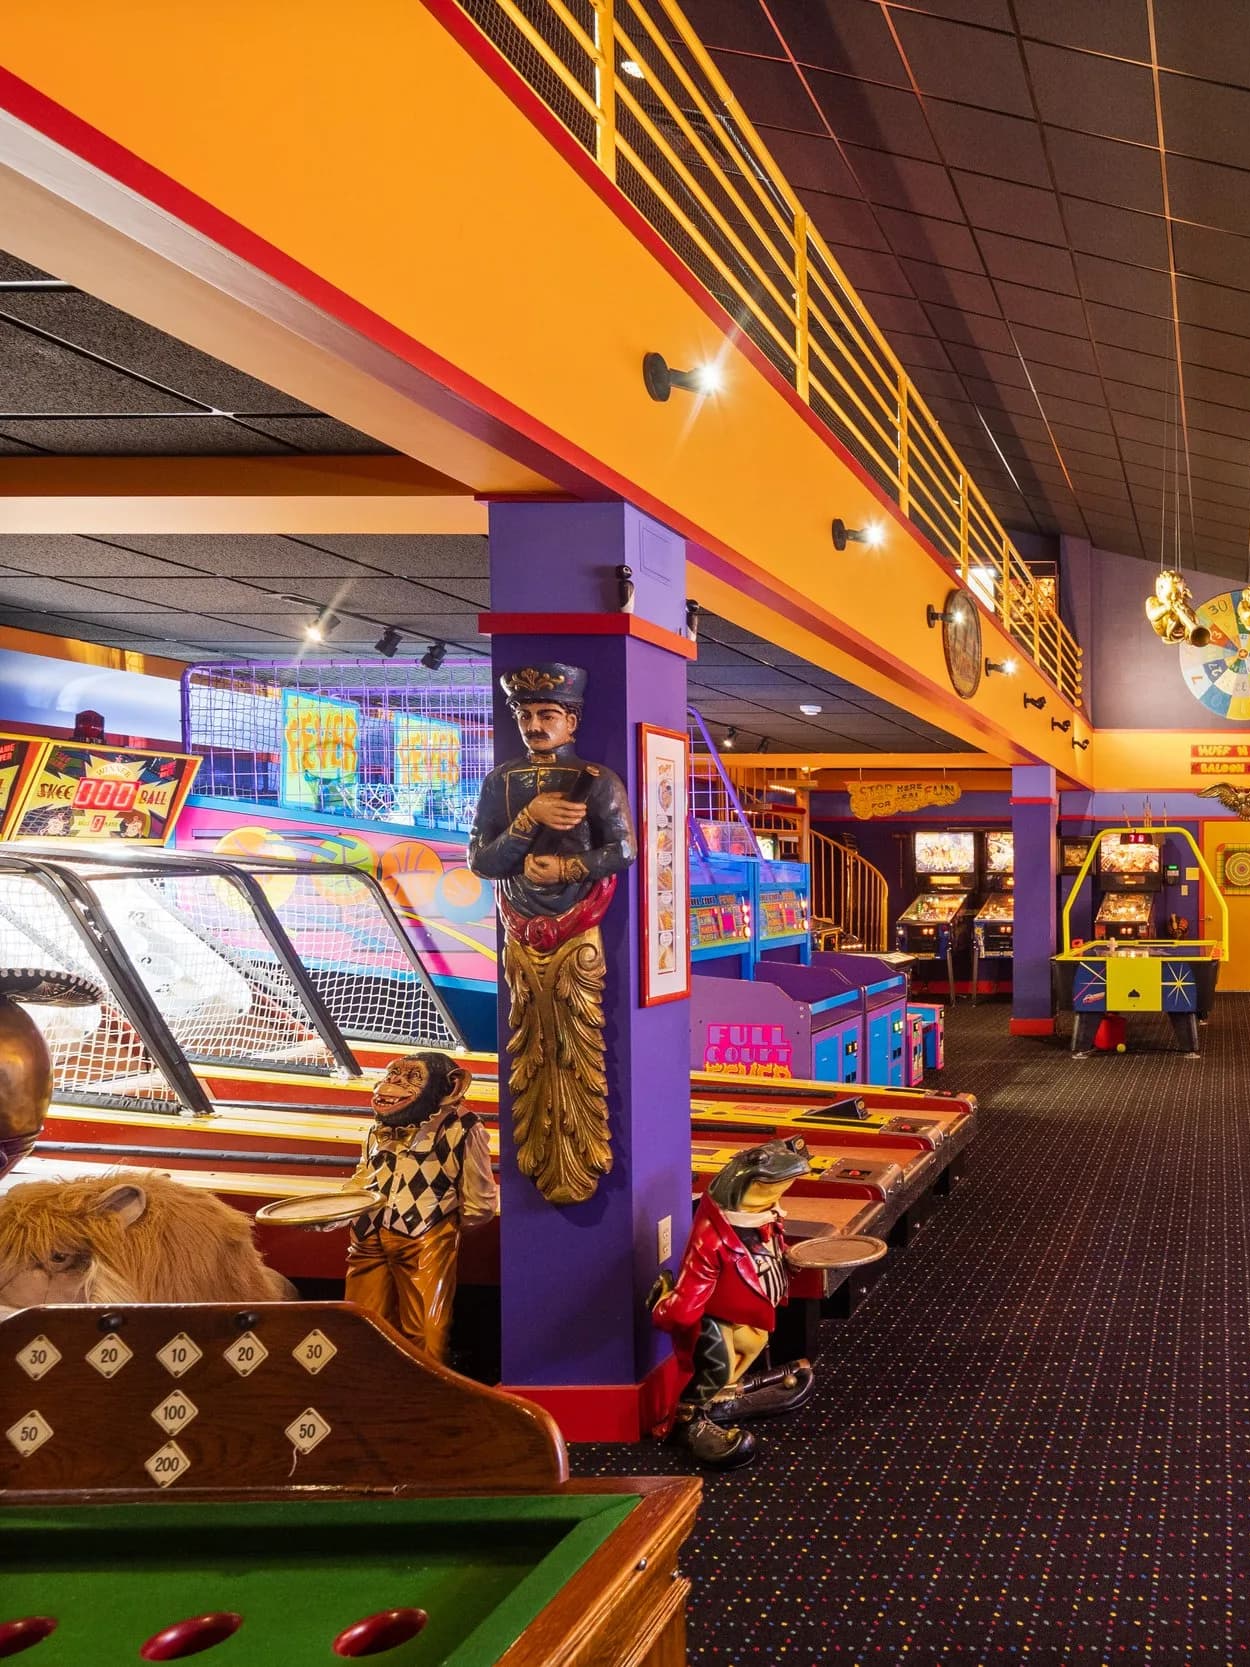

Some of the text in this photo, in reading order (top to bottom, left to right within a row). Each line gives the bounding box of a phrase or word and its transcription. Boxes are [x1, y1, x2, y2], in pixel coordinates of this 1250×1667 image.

[1208, 600, 1228, 615] 30
[37, 783, 75, 799] SKEE
[74, 779, 134, 808] 000
[139, 790, 168, 805] BALL
[709, 1026, 788, 1046] FULL
[706, 1046, 791, 1062] COURT
[30, 1350, 47, 1365] 30
[101, 1348, 118, 1363] 20
[171, 1348, 187, 1362] 10
[237, 1347, 254, 1361] 20
[306, 1344, 323, 1359] 30
[163, 1405, 186, 1420] 100
[20, 1426, 38, 1441] 50
[299, 1423, 316, 1438] 50
[155, 1457, 180, 1472] 200
